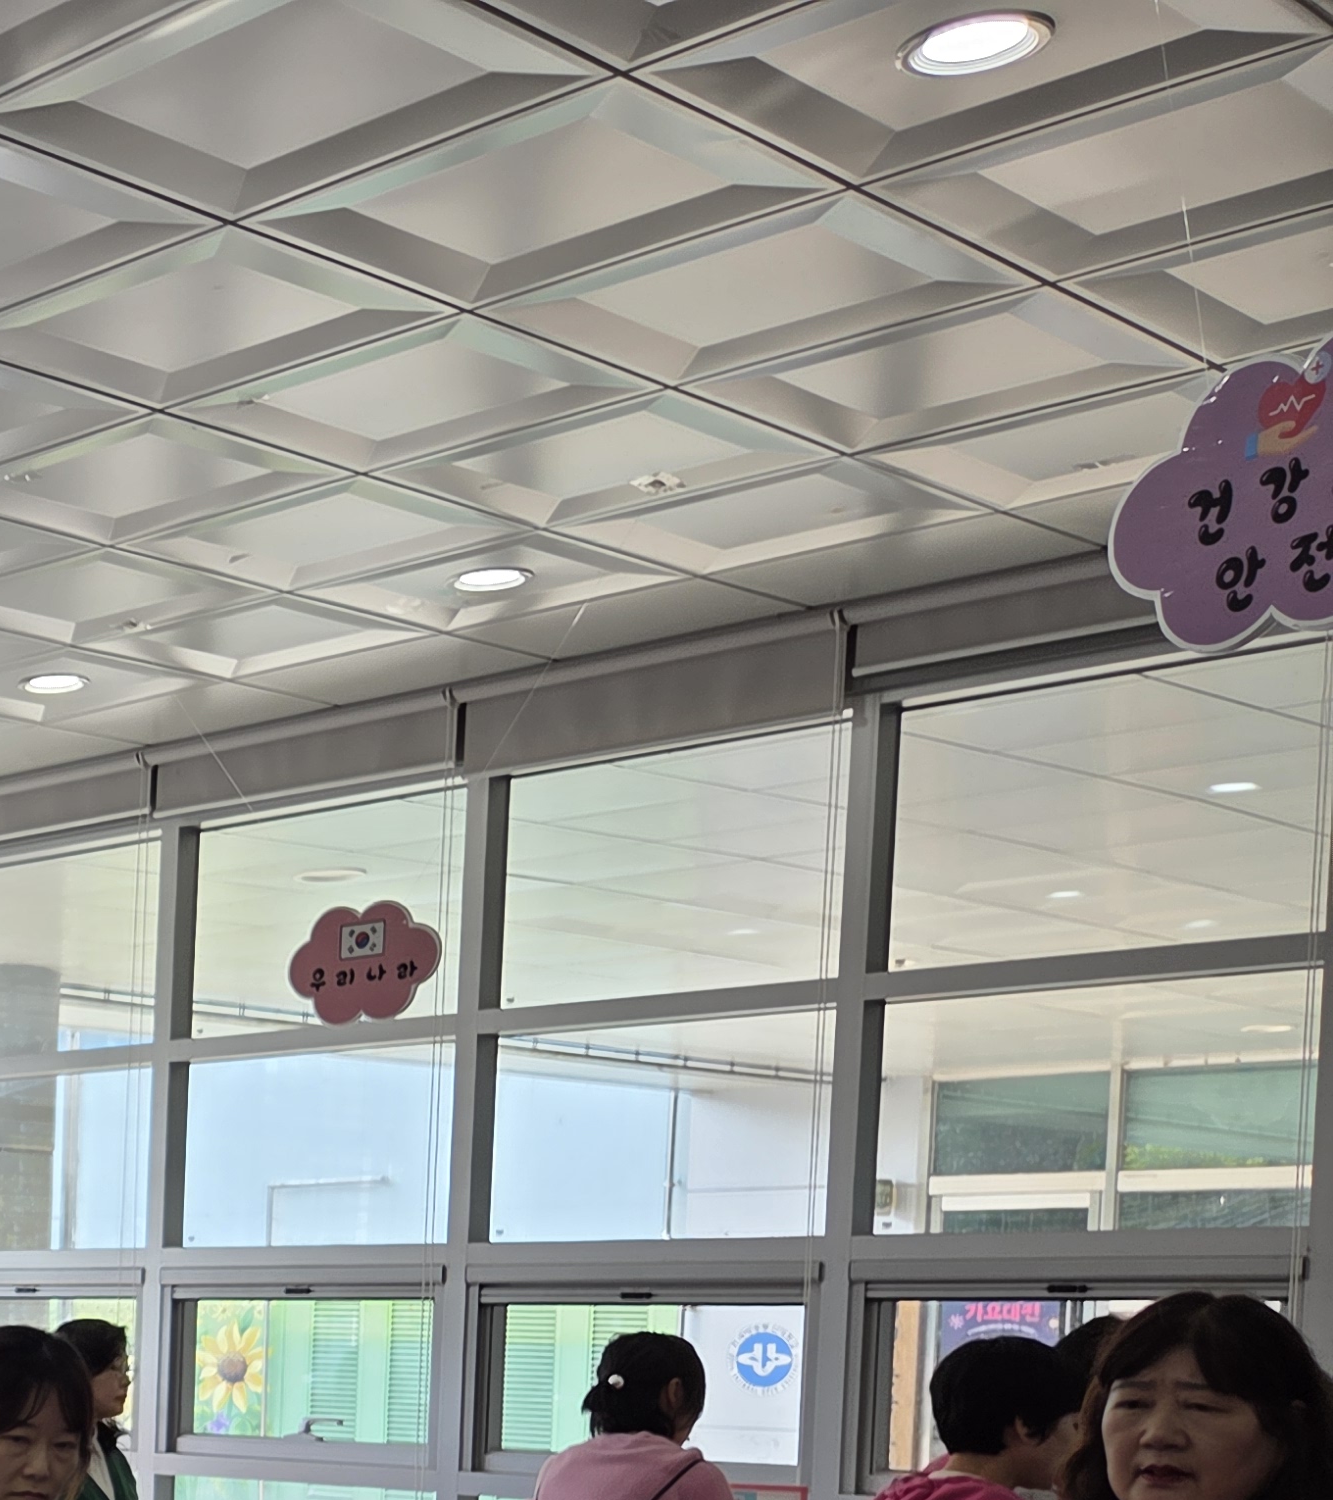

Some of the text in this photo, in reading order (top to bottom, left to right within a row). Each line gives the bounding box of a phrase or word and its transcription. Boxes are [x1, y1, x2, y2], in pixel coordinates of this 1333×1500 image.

[1188, 457, 1310, 546] 건강
[1215, 524, 1333, 613] 안전
[310, 960, 418, 992] 우리나라
